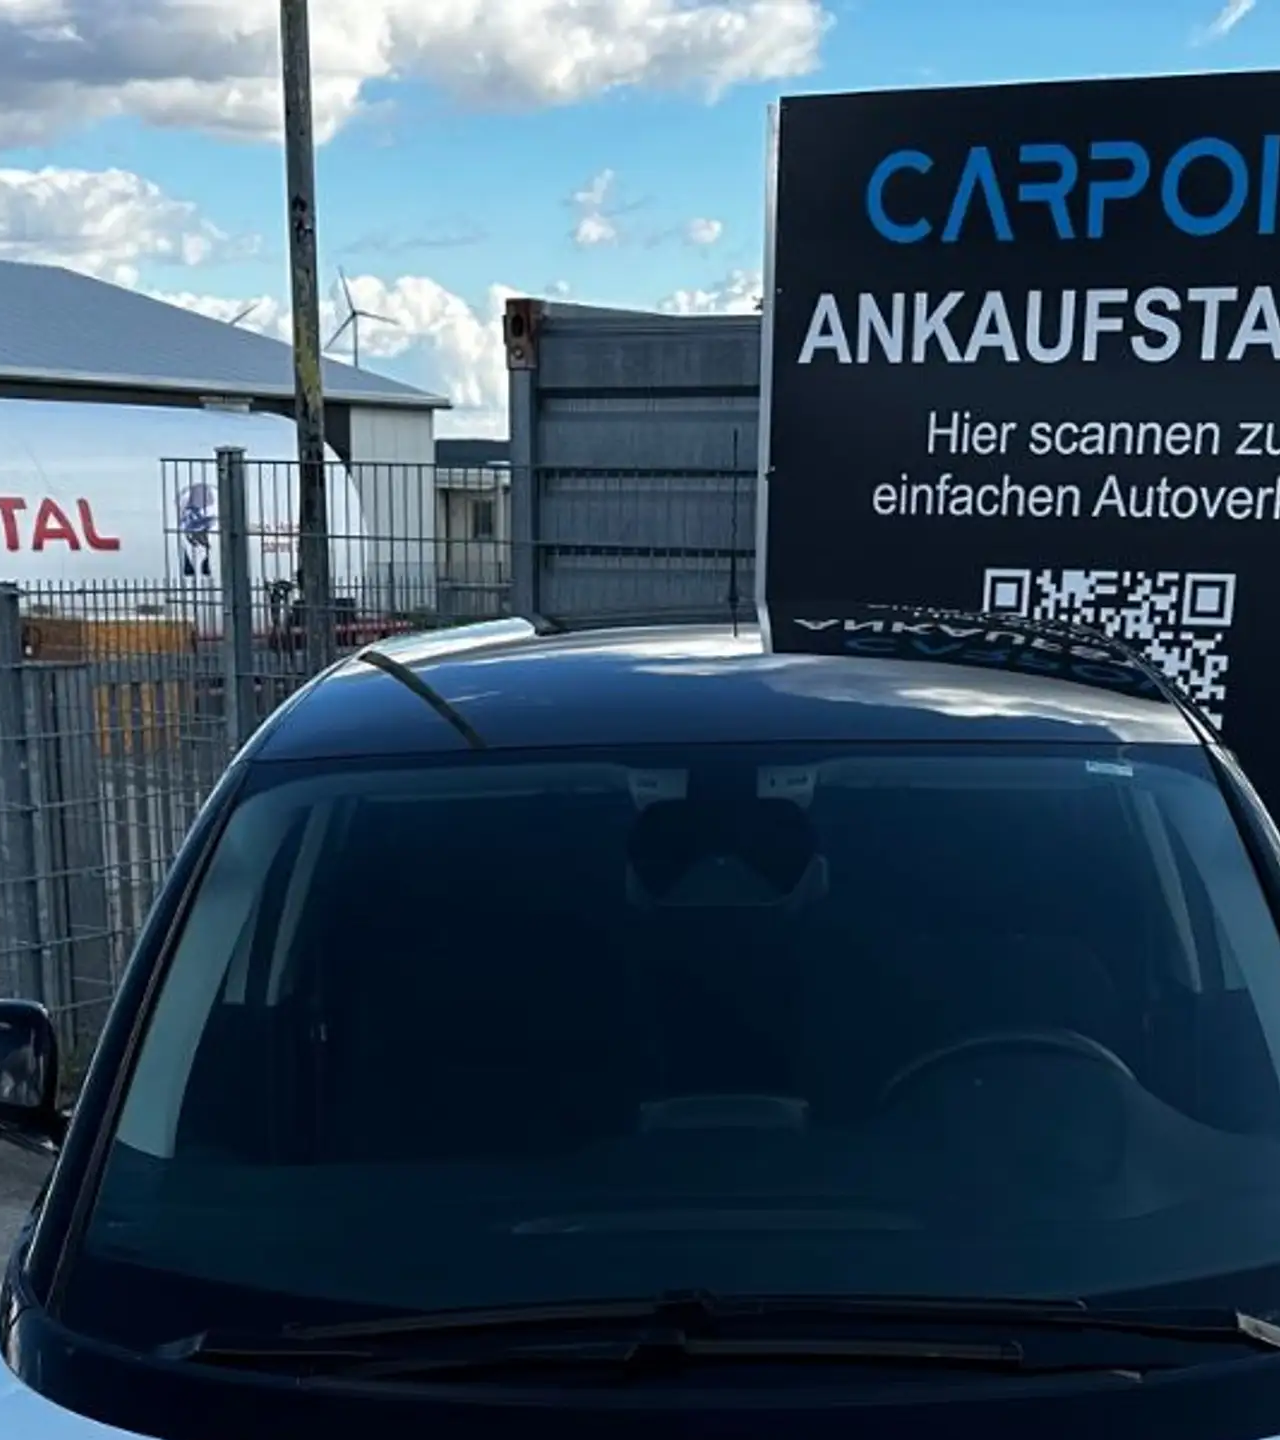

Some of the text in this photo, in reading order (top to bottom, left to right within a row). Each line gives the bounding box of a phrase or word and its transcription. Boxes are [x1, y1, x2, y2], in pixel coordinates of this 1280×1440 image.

[926, 410, 1017, 456] Hier
[1028, 421, 1221, 457] scannen
[871, 472, 1081, 518] einfachen
